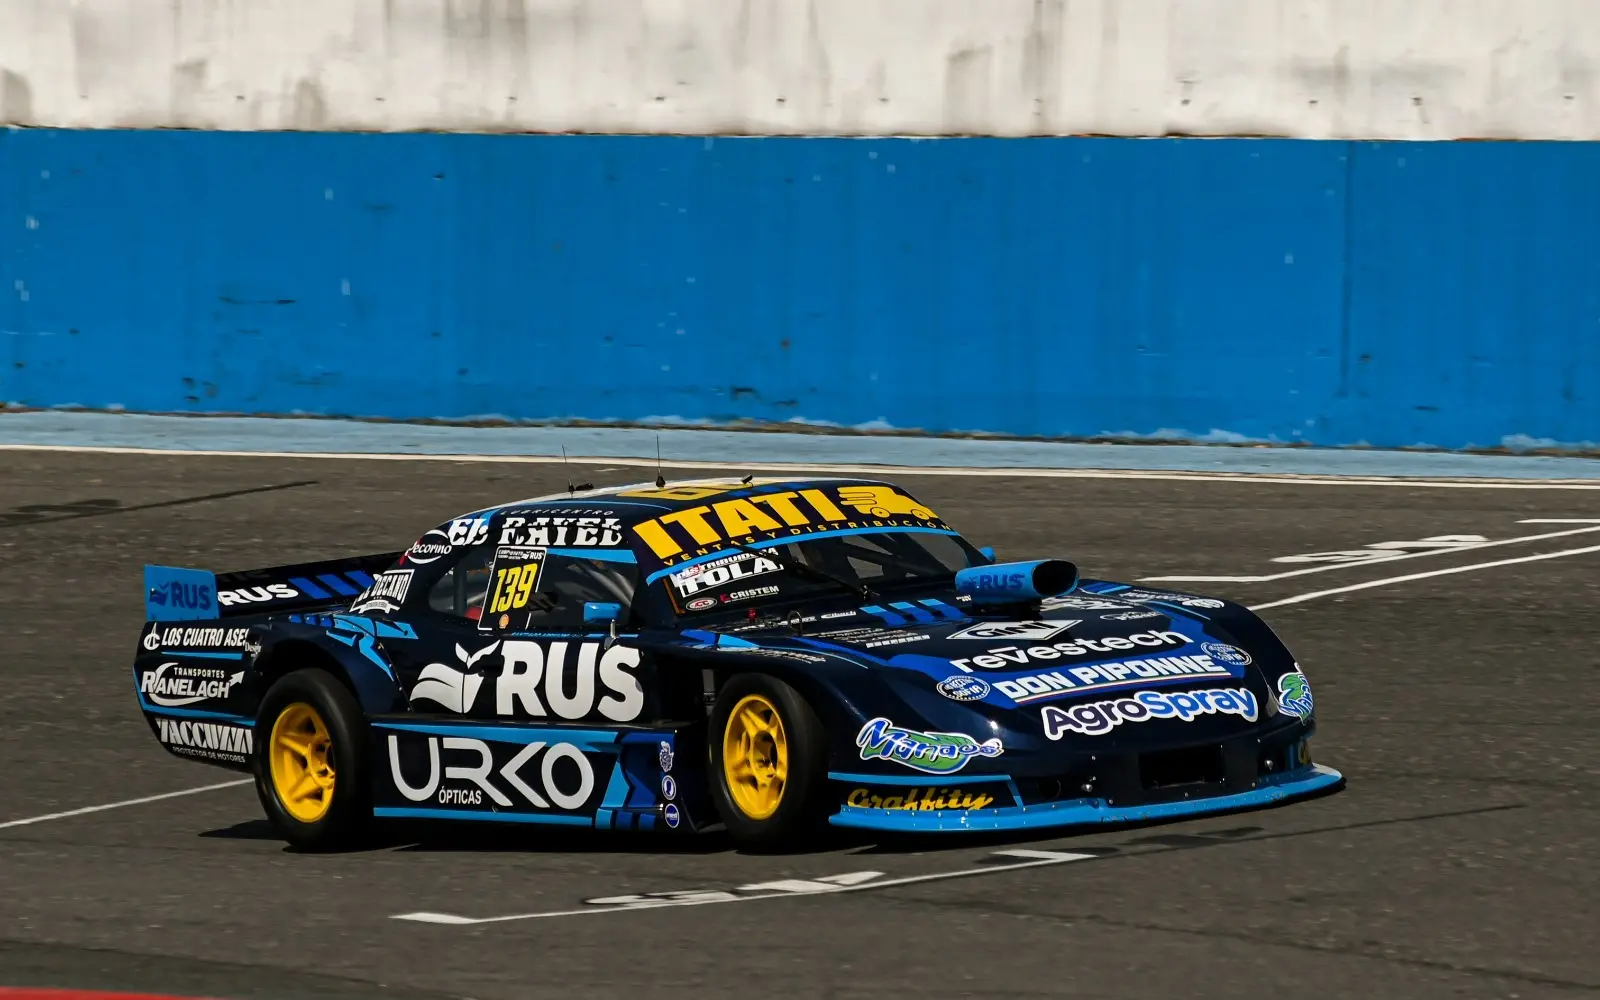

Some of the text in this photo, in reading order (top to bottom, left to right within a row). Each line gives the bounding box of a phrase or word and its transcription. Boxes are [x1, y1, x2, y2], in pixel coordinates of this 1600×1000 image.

[632, 489, 848, 560] ITATI
[530, 552, 543, 560] RUS
[664, 519, 952, 566] VENTAS Y DISTRIBUCIÓN
[490, 563, 538, 613] 139
[680, 557, 778, 594] TOLA
[730, 585, 779, 599] CRISTEM
[980, 573, 1025, 591] RUS
[170, 581, 211, 611] RUS
[218, 583, 298, 606] RUS
[161, 628, 183, 646] LOS
[183, 628, 224, 646] CUATRO
[950, 628, 1194, 674] revestech
[141, 671, 230, 698] RANELAGH
[174, 667, 225, 679] TRANSPORTES
[496, 640, 644, 721] RUS
[991, 654, 1226, 699] DON PIPONNE
[1044, 688, 1257, 740] AgroSpray
[208, 751, 217, 759] DE
[217, 753, 246, 763] MOTORES
[857, 719, 1000, 762] Manaos
[388, 735, 594, 809] URKO
[438, 786, 482, 805] ÓPTICAS
